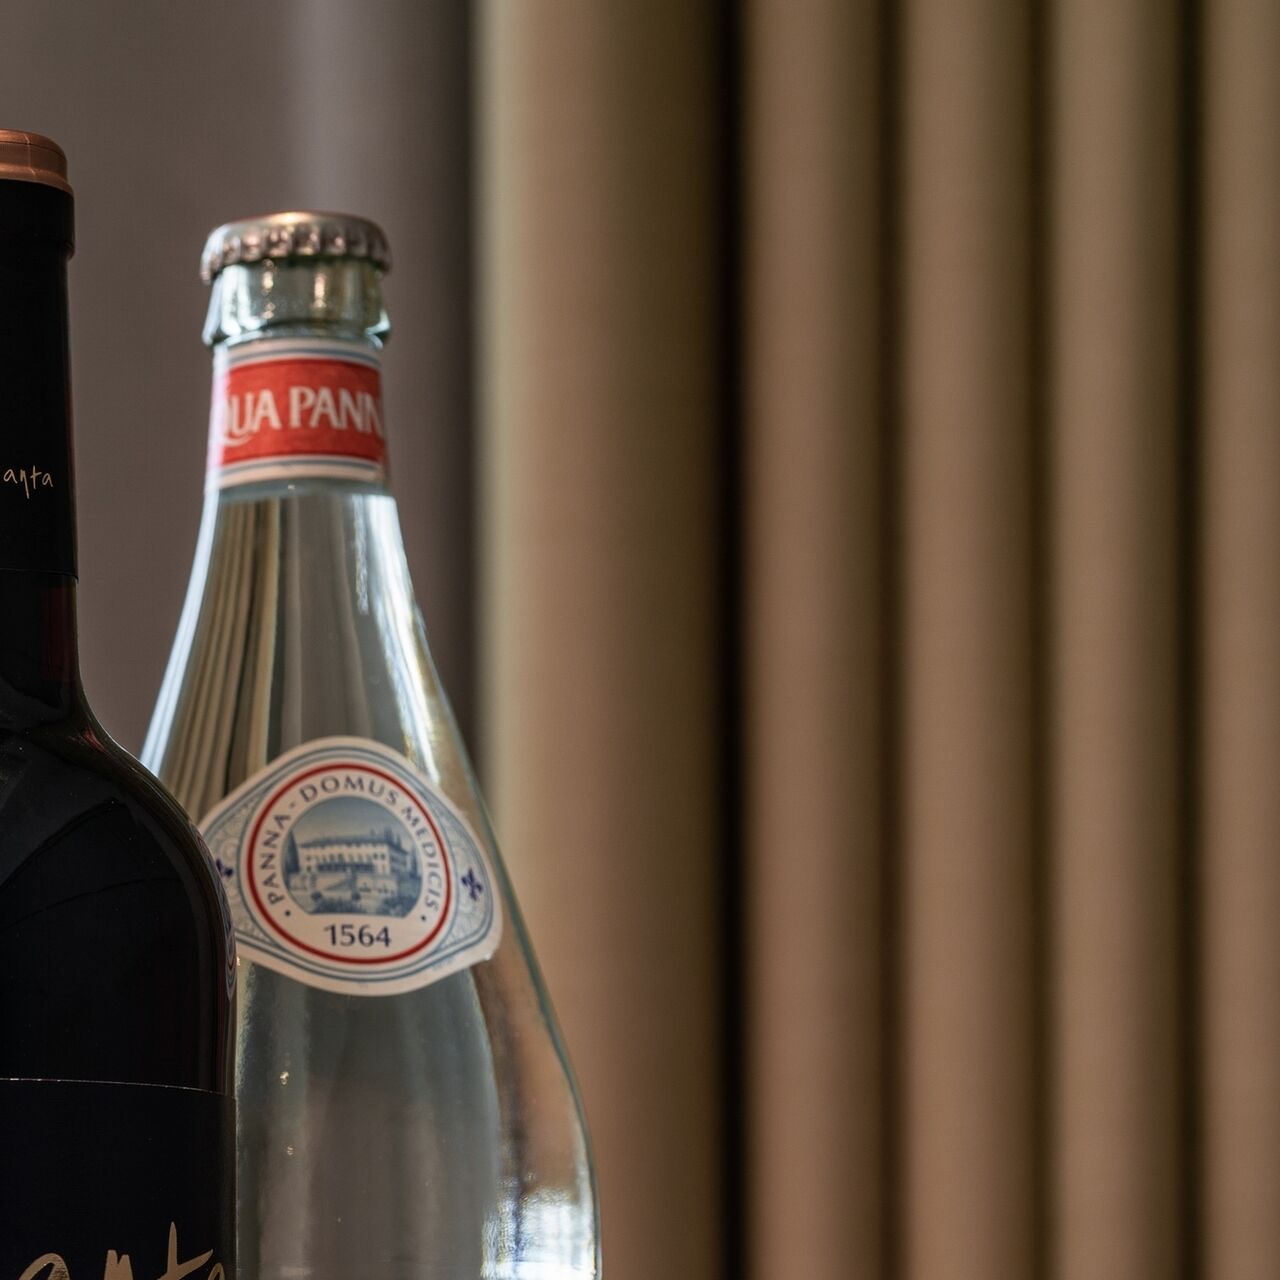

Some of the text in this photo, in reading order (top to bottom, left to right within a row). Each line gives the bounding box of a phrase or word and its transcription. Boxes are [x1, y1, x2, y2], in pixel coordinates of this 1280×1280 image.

[224, 388, 282, 447] UA
[260, 775, 442, 913] PANNA DOMUS MEDICIS
[323, 923, 392, 948] 1564
